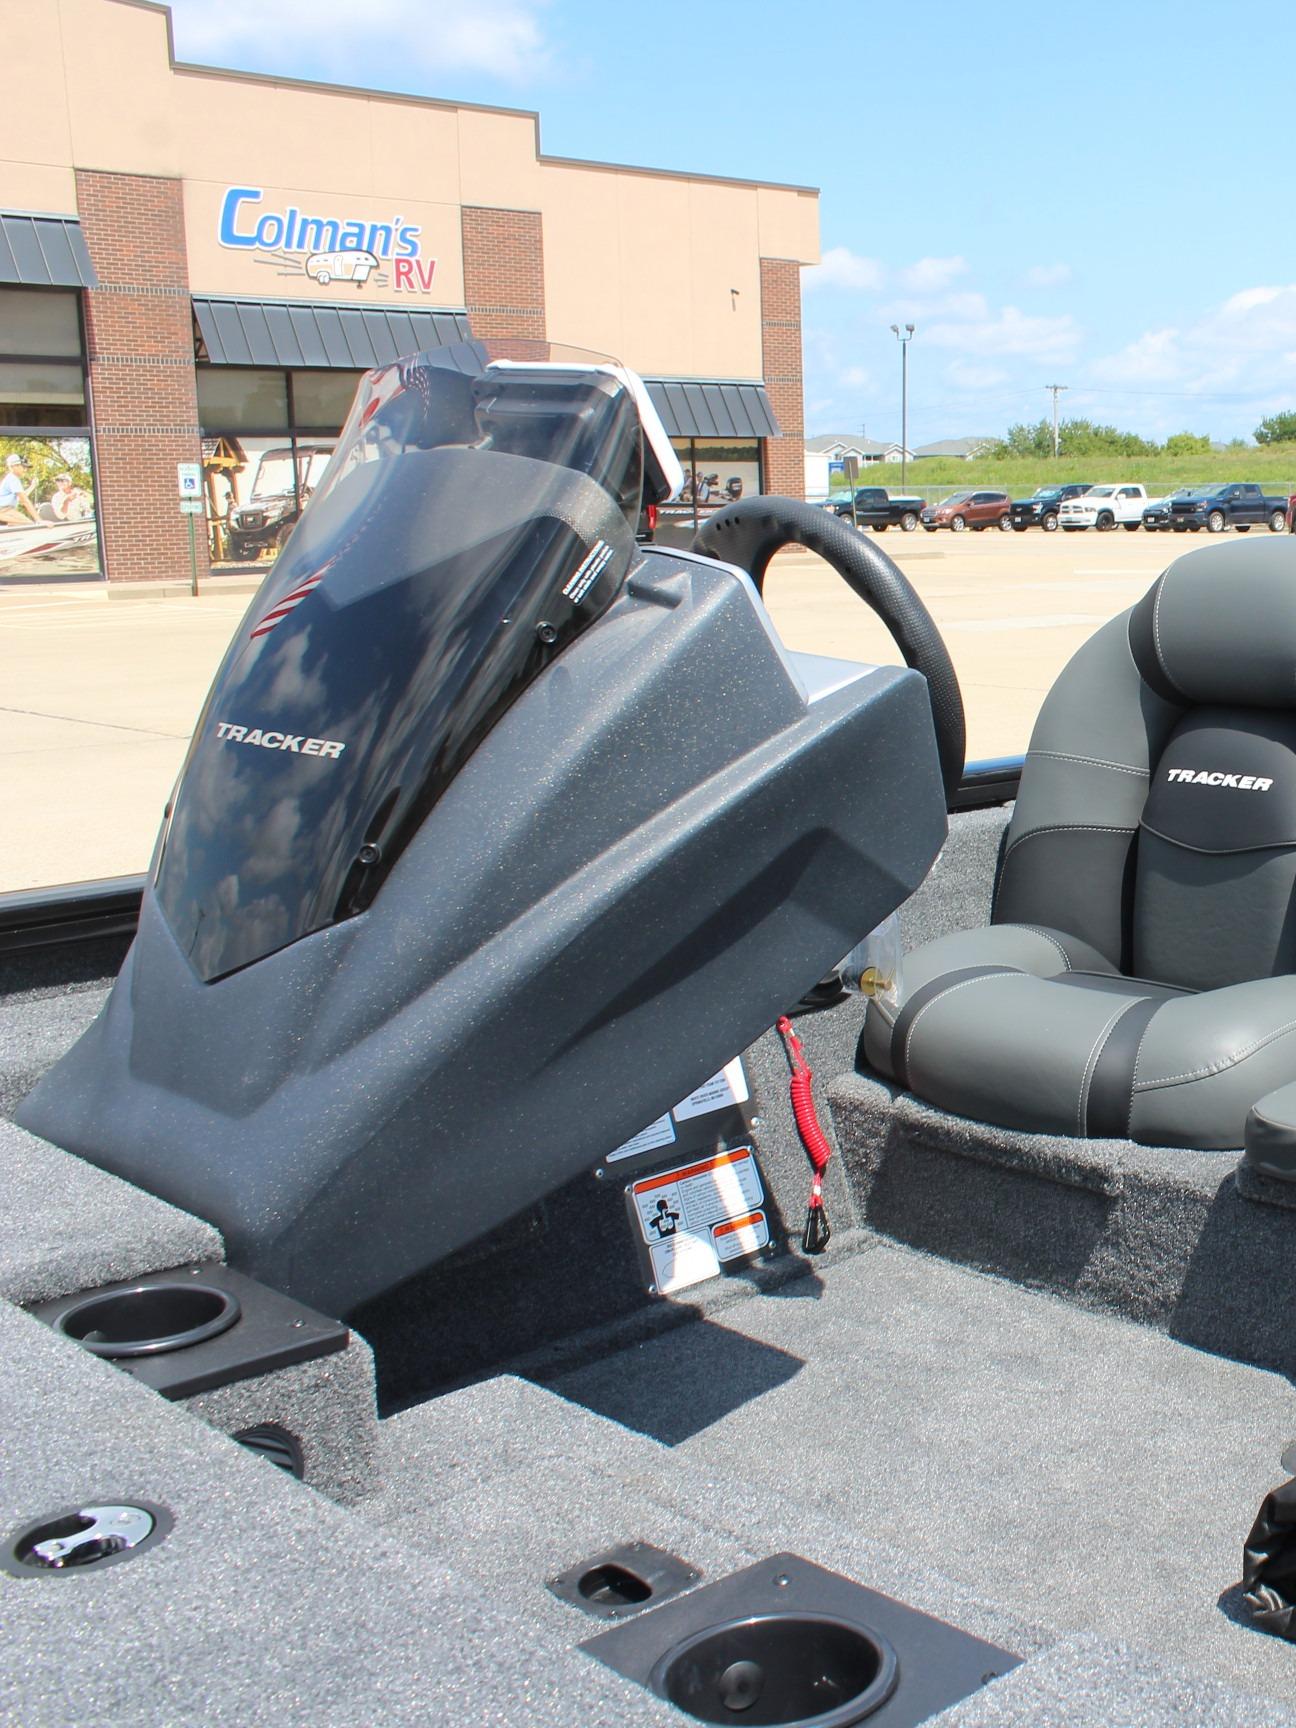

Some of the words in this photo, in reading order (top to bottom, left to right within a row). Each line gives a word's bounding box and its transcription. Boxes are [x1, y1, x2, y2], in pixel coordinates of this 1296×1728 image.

[218, 187, 421, 258] Colman's
[393, 257, 437, 291] RV
[216, 722, 346, 759] TRACKER
[1167, 768, 1274, 792] TRACKER
